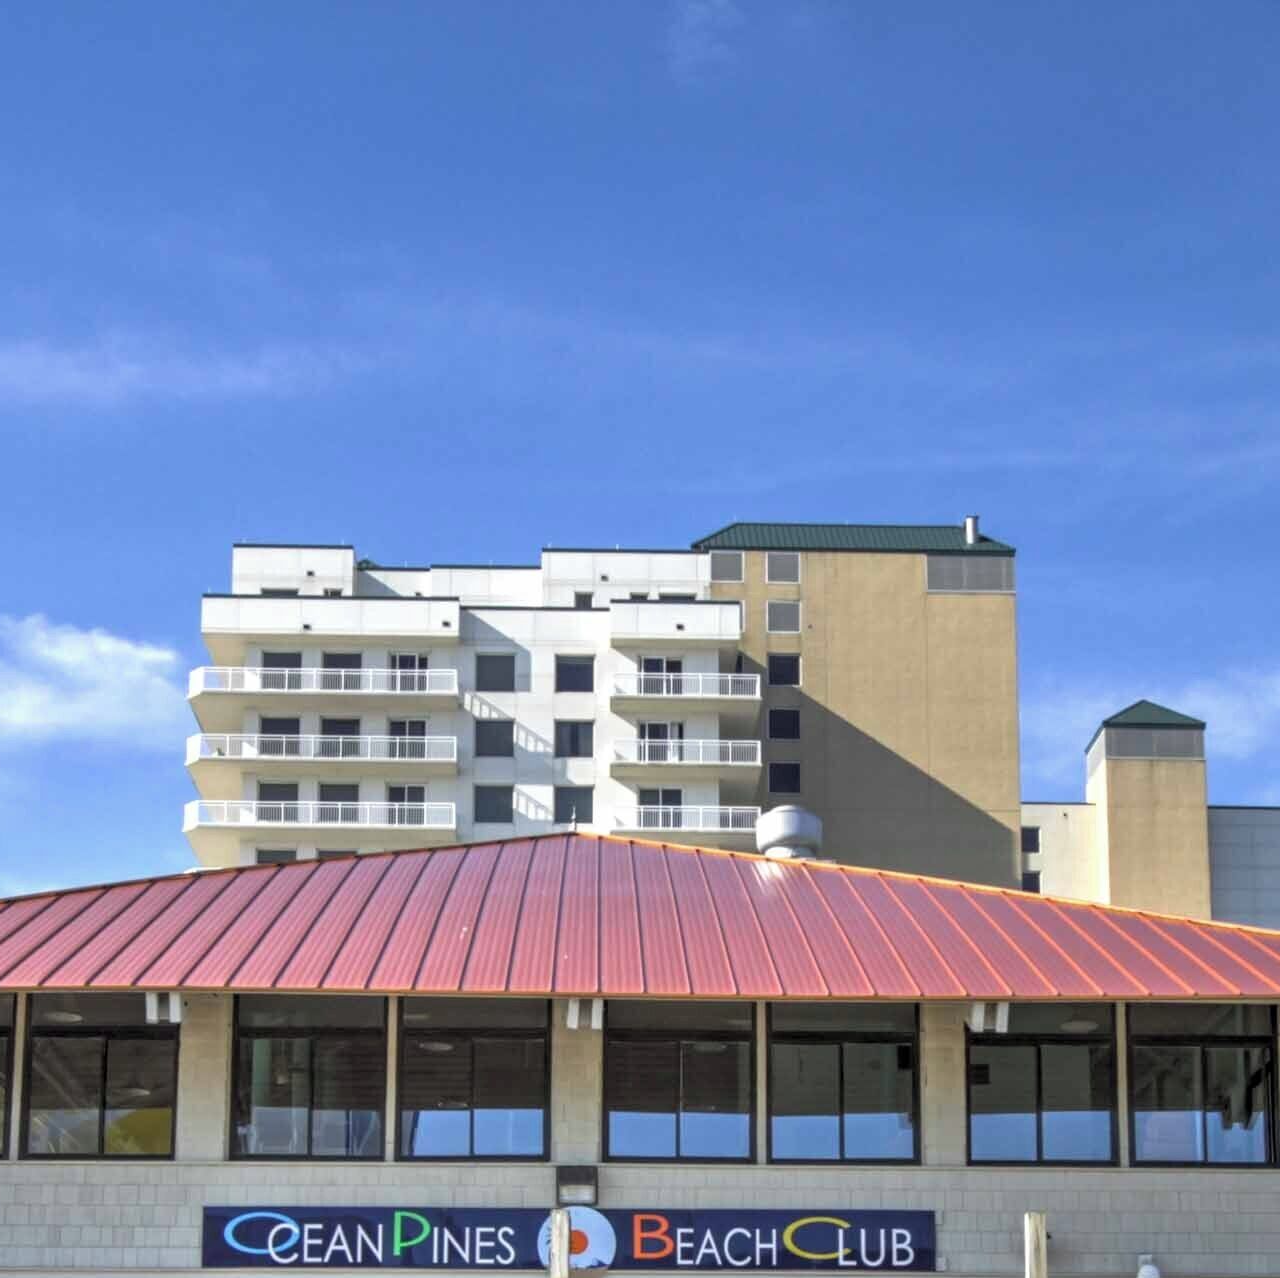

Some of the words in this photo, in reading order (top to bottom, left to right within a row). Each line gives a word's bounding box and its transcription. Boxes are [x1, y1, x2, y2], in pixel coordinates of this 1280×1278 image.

[223, 1210, 383, 1264] OCEAN
[393, 1211, 515, 1265] PINES
[633, 1213, 778, 1266] BEACH
[782, 1216, 915, 1267] CLUB
